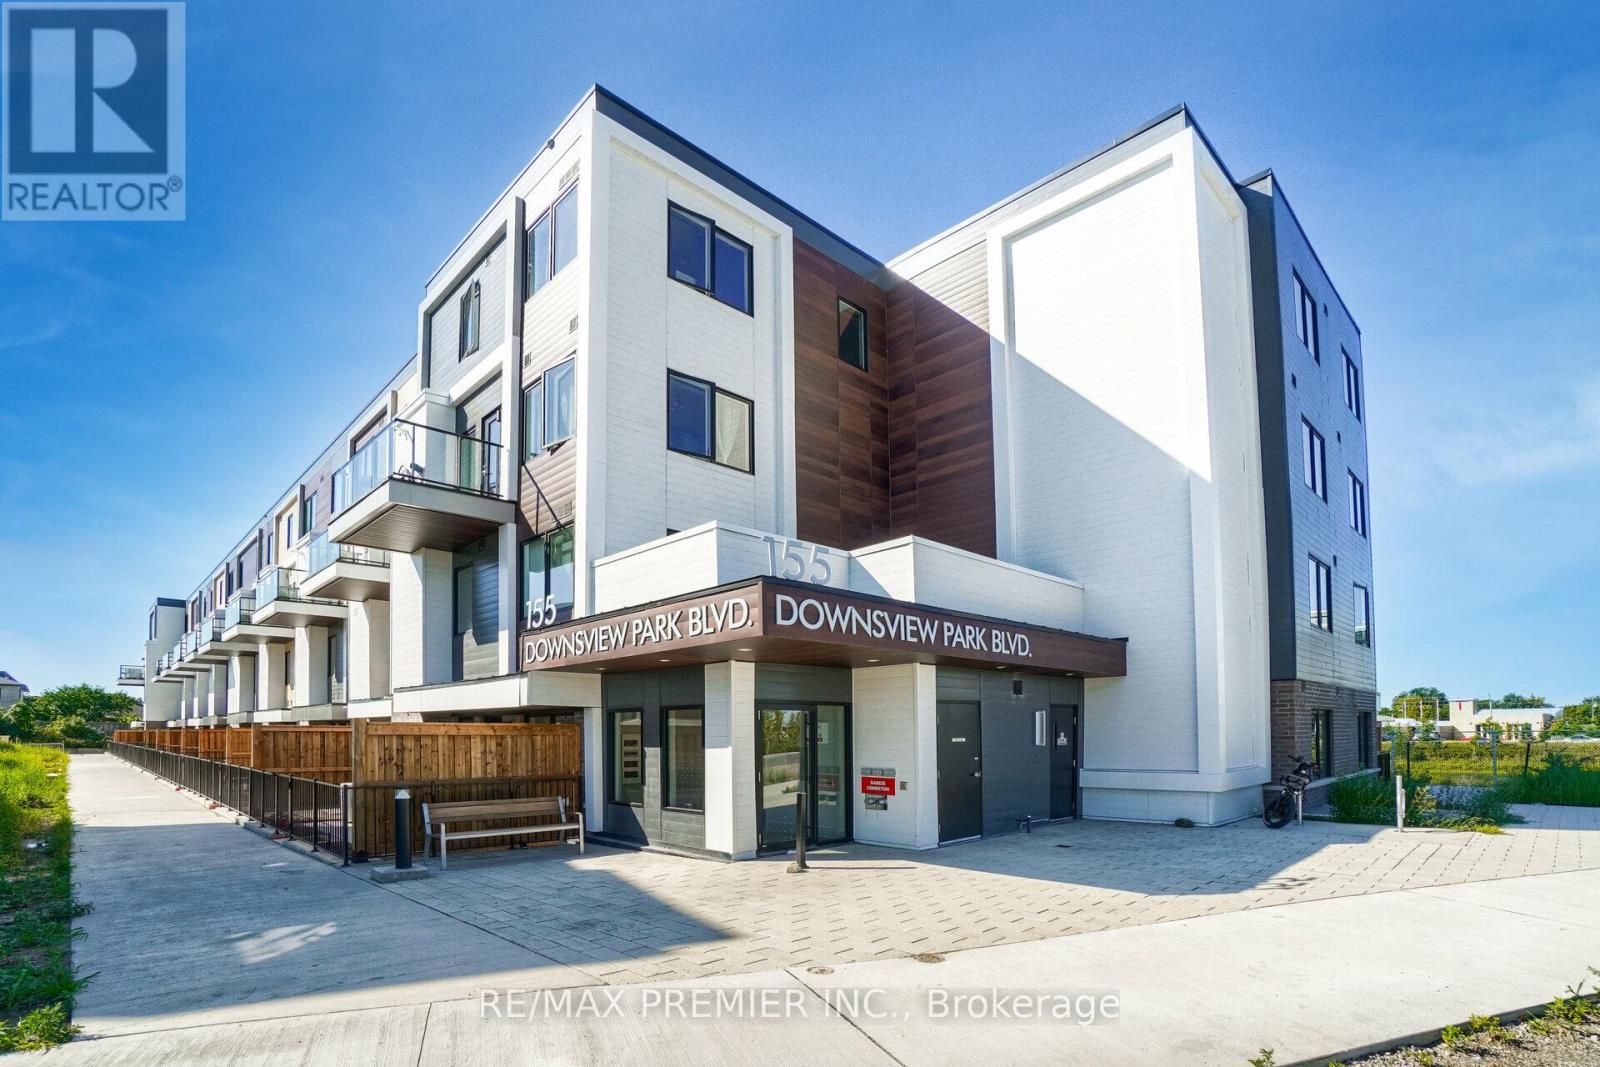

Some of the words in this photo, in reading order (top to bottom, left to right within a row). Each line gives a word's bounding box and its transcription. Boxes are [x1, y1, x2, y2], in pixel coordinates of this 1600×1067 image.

[761, 535, 831, 584] 155
[525, 593, 557, 631] 155
[525, 621, 629, 664] DOWNSVIEW
[632, 610, 683, 647] PARK
[688, 598, 754, 637] BLVD.
[775, 593, 939, 645] DOWNSVIEW
[943, 621, 988, 651] PARK
[992, 629, 1033, 658] BLVD.
